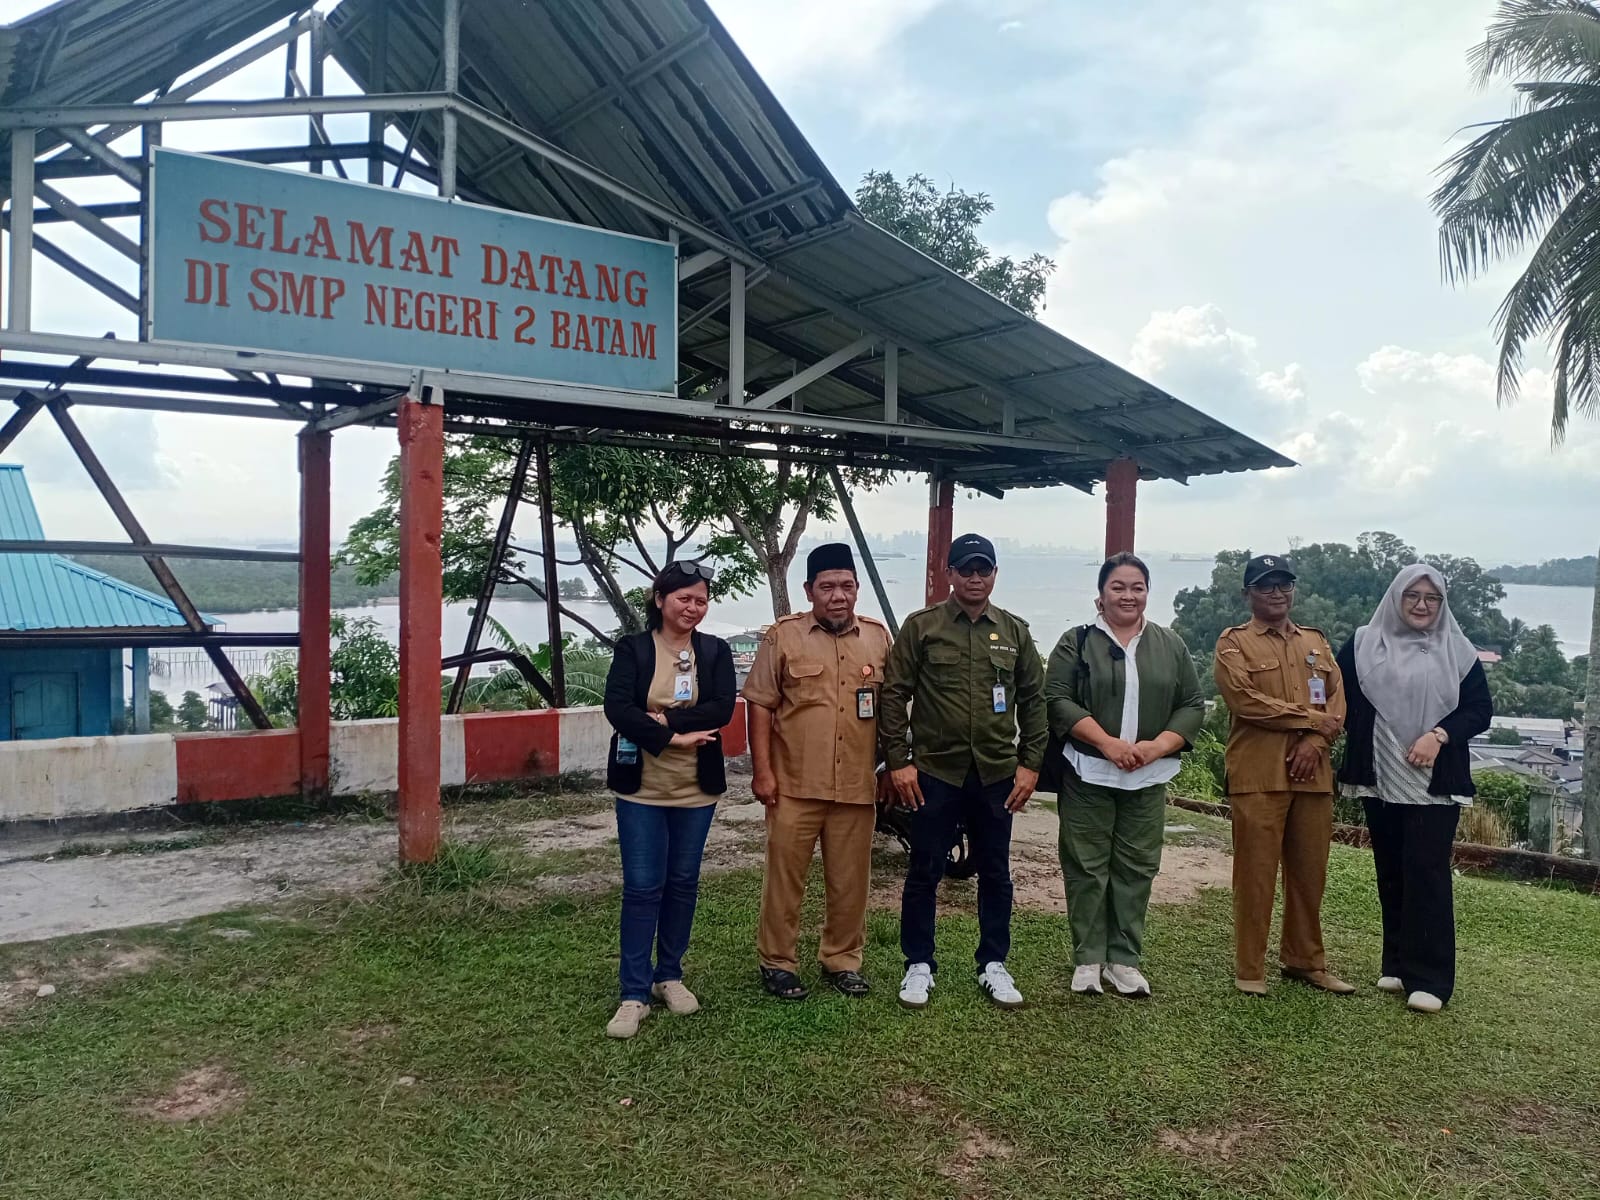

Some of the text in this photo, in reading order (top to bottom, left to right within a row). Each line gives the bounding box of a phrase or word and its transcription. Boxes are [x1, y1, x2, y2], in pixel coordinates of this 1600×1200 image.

[198, 198, 647, 308] SELAMAT DATANG
[184, 258, 657, 361] DI SMP NEGERI 2 BATAM
